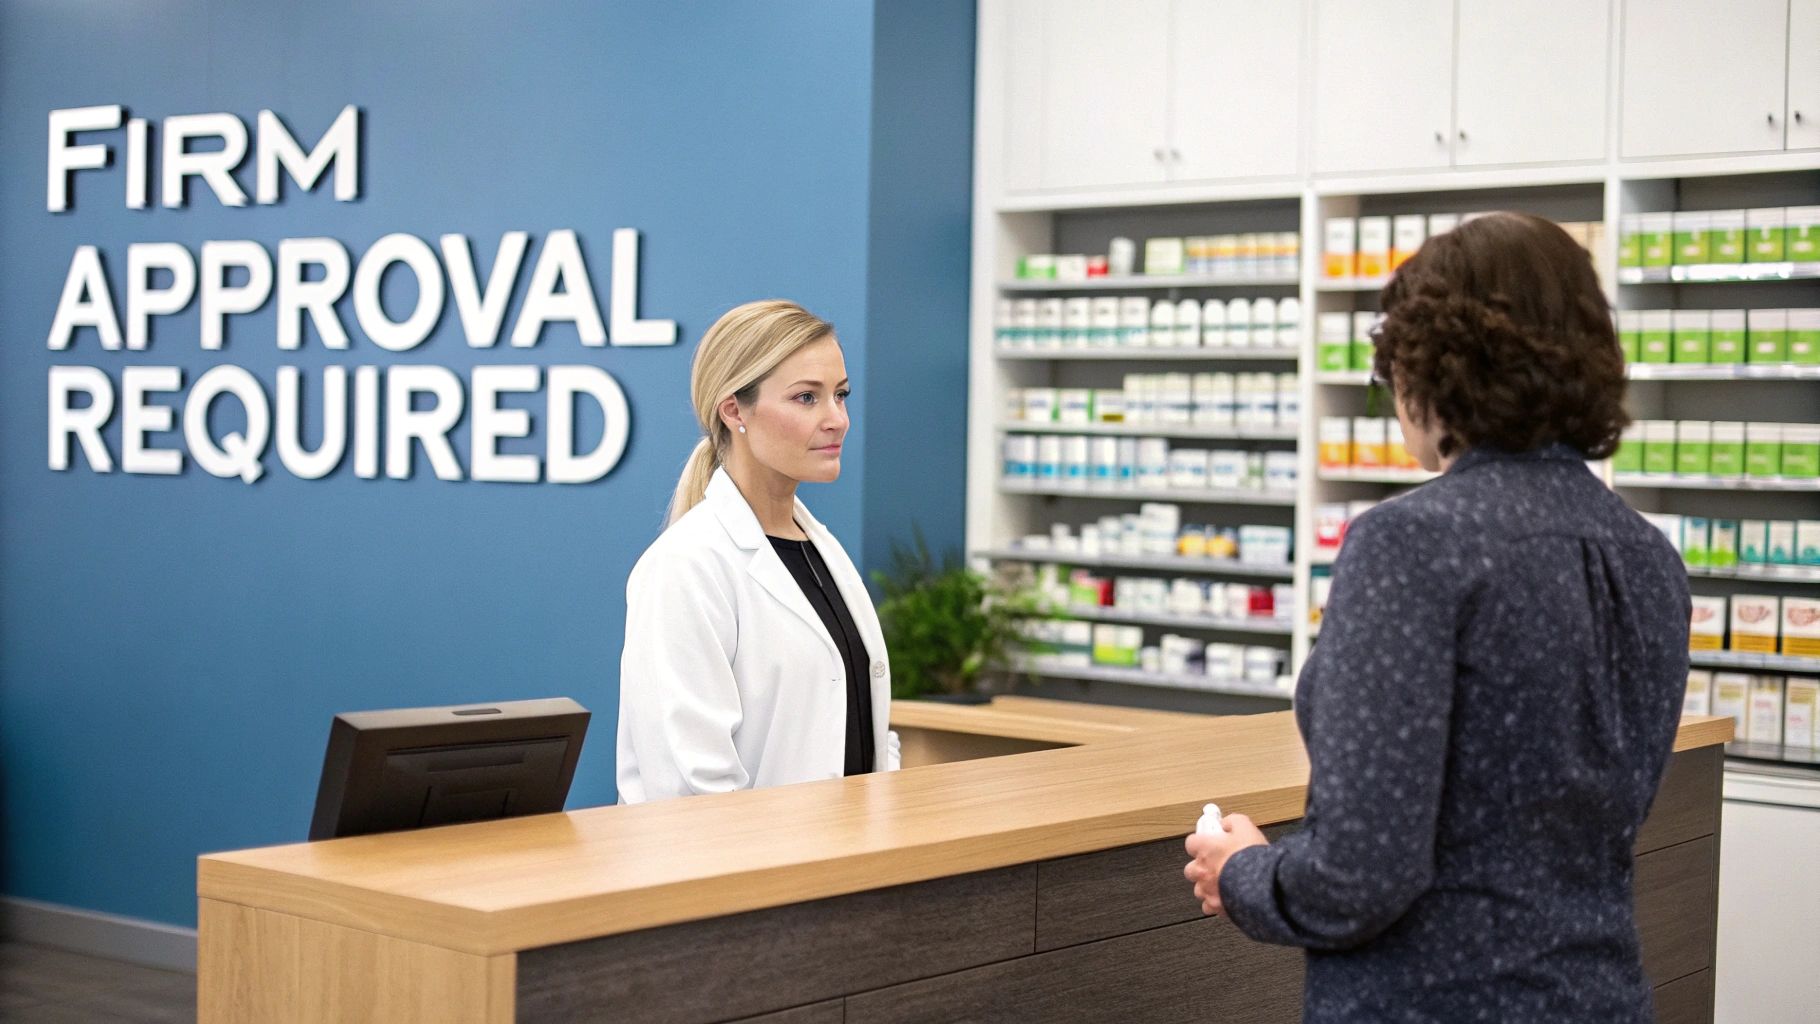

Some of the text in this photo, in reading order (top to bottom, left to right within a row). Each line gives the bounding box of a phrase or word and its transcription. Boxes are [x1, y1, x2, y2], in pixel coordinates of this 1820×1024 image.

[47, 104, 358, 211] FIRM
[48, 228, 675, 350] APPROVAL
[48, 364, 630, 483] REQUIRED
